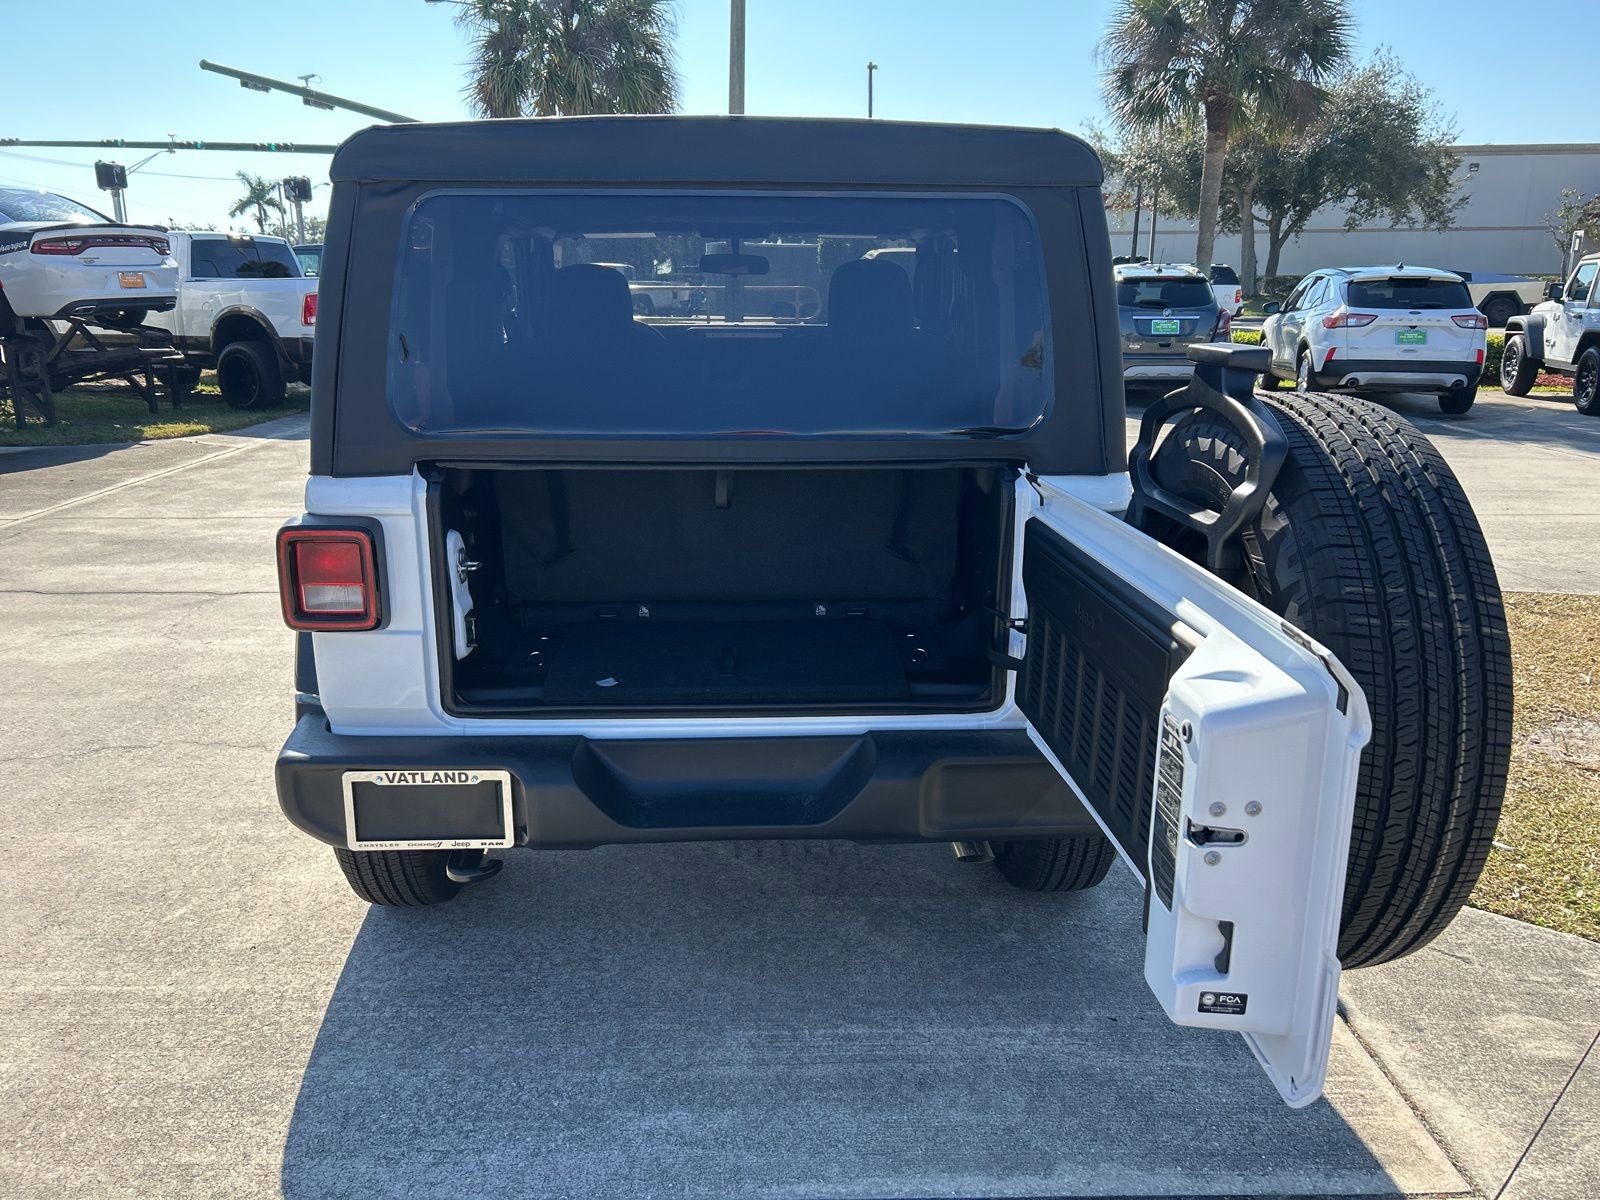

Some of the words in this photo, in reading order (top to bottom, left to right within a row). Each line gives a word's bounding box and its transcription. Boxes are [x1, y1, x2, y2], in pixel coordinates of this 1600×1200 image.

[384, 772, 469, 784] VATLAND
[451, 840, 471, 848] Jeep
[1219, 995, 1241, 1004] FCA
